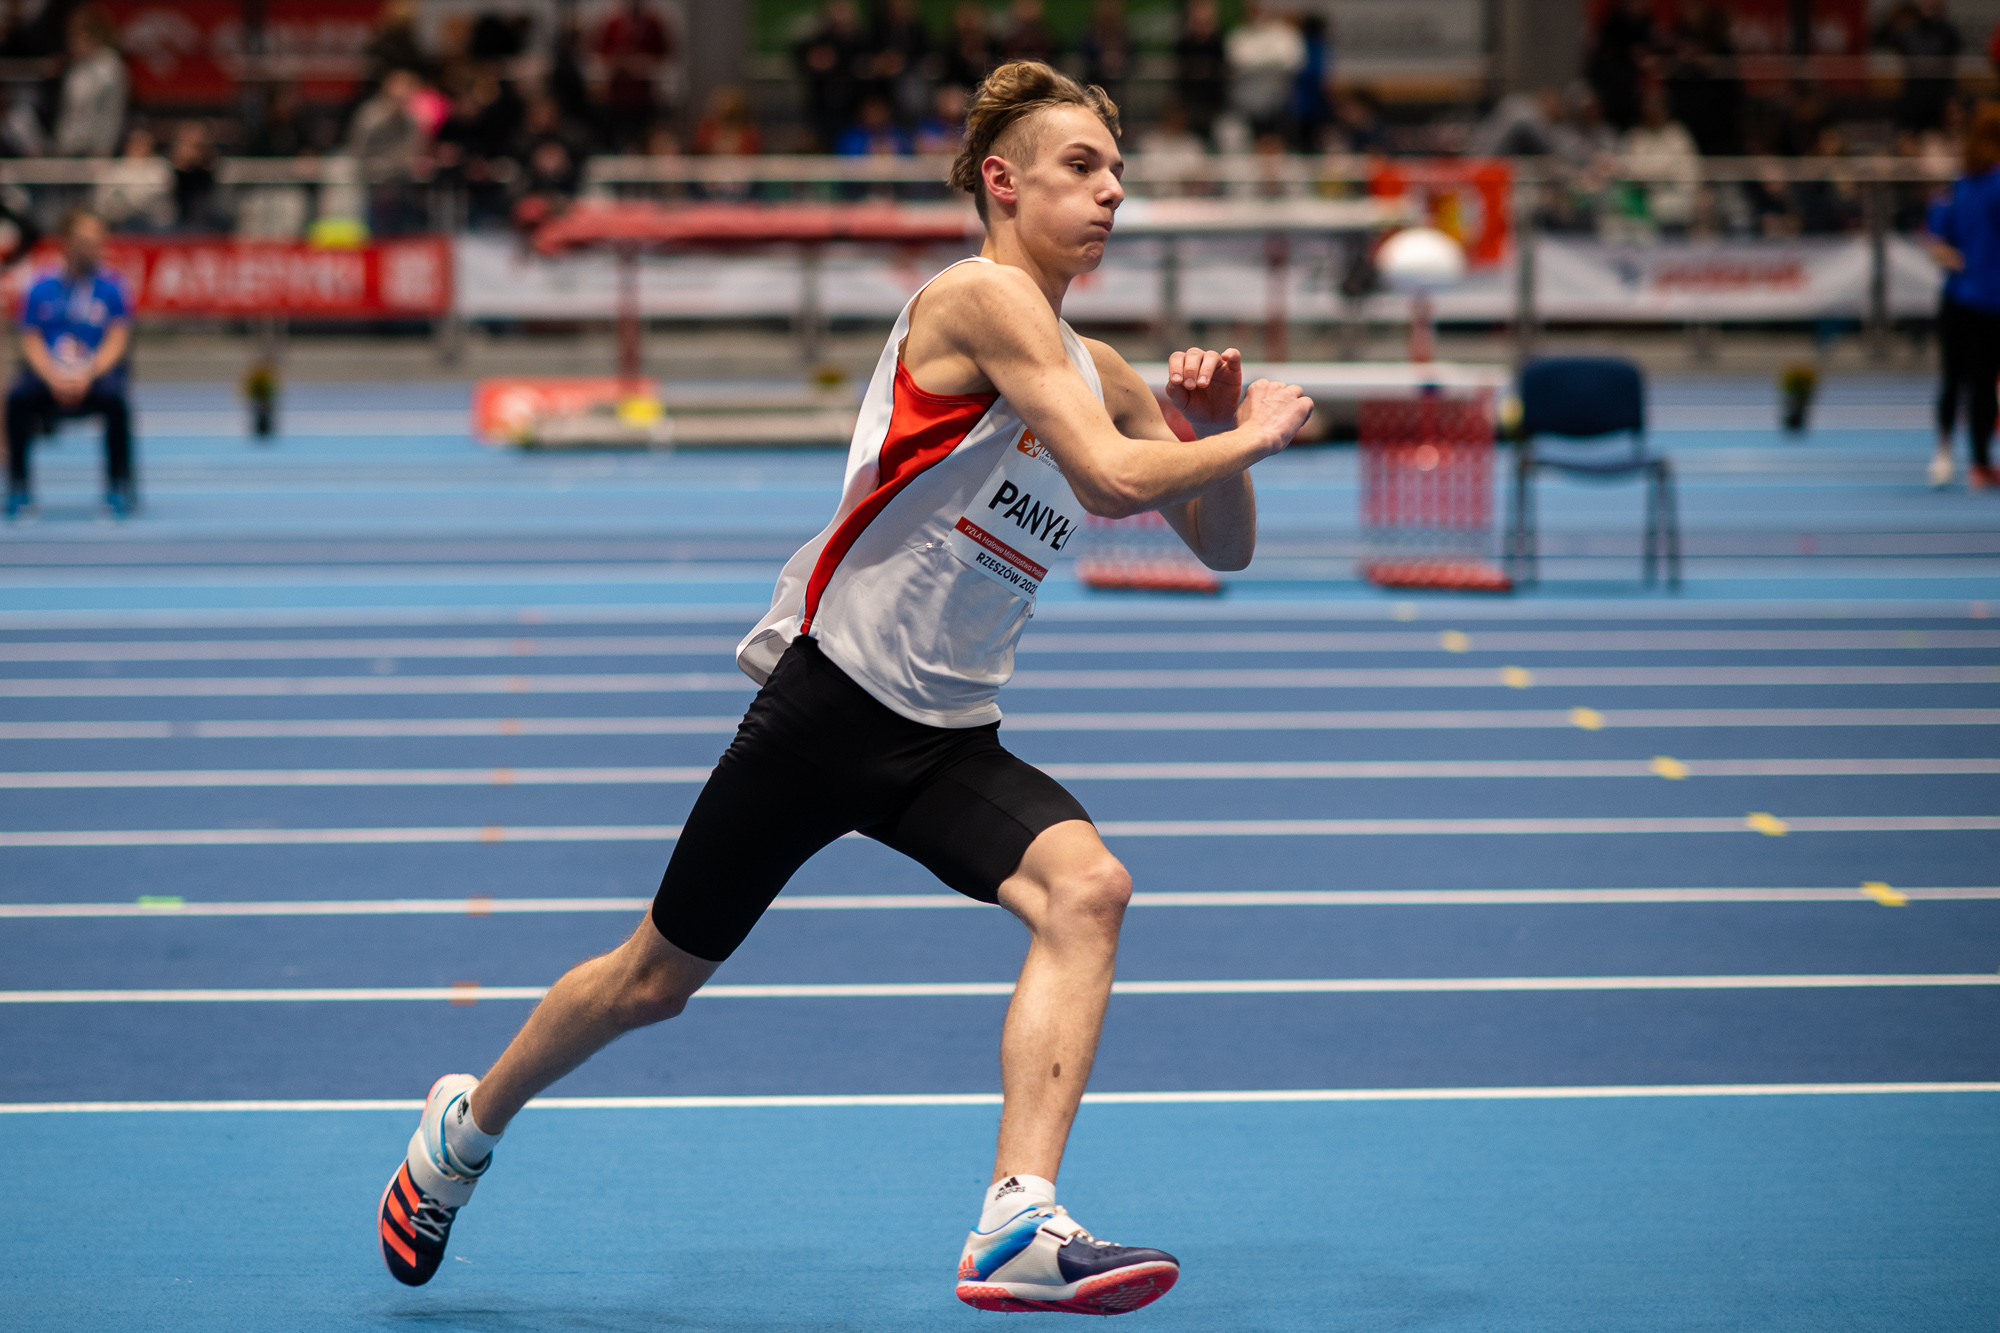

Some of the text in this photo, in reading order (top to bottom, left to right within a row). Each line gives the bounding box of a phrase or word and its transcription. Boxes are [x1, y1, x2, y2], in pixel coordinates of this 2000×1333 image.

[964, 524, 982, 540] PZLA
[1003, 547, 1033, 572] Mistrzostwa
[975, 551, 1022, 584] RZESZÓW
